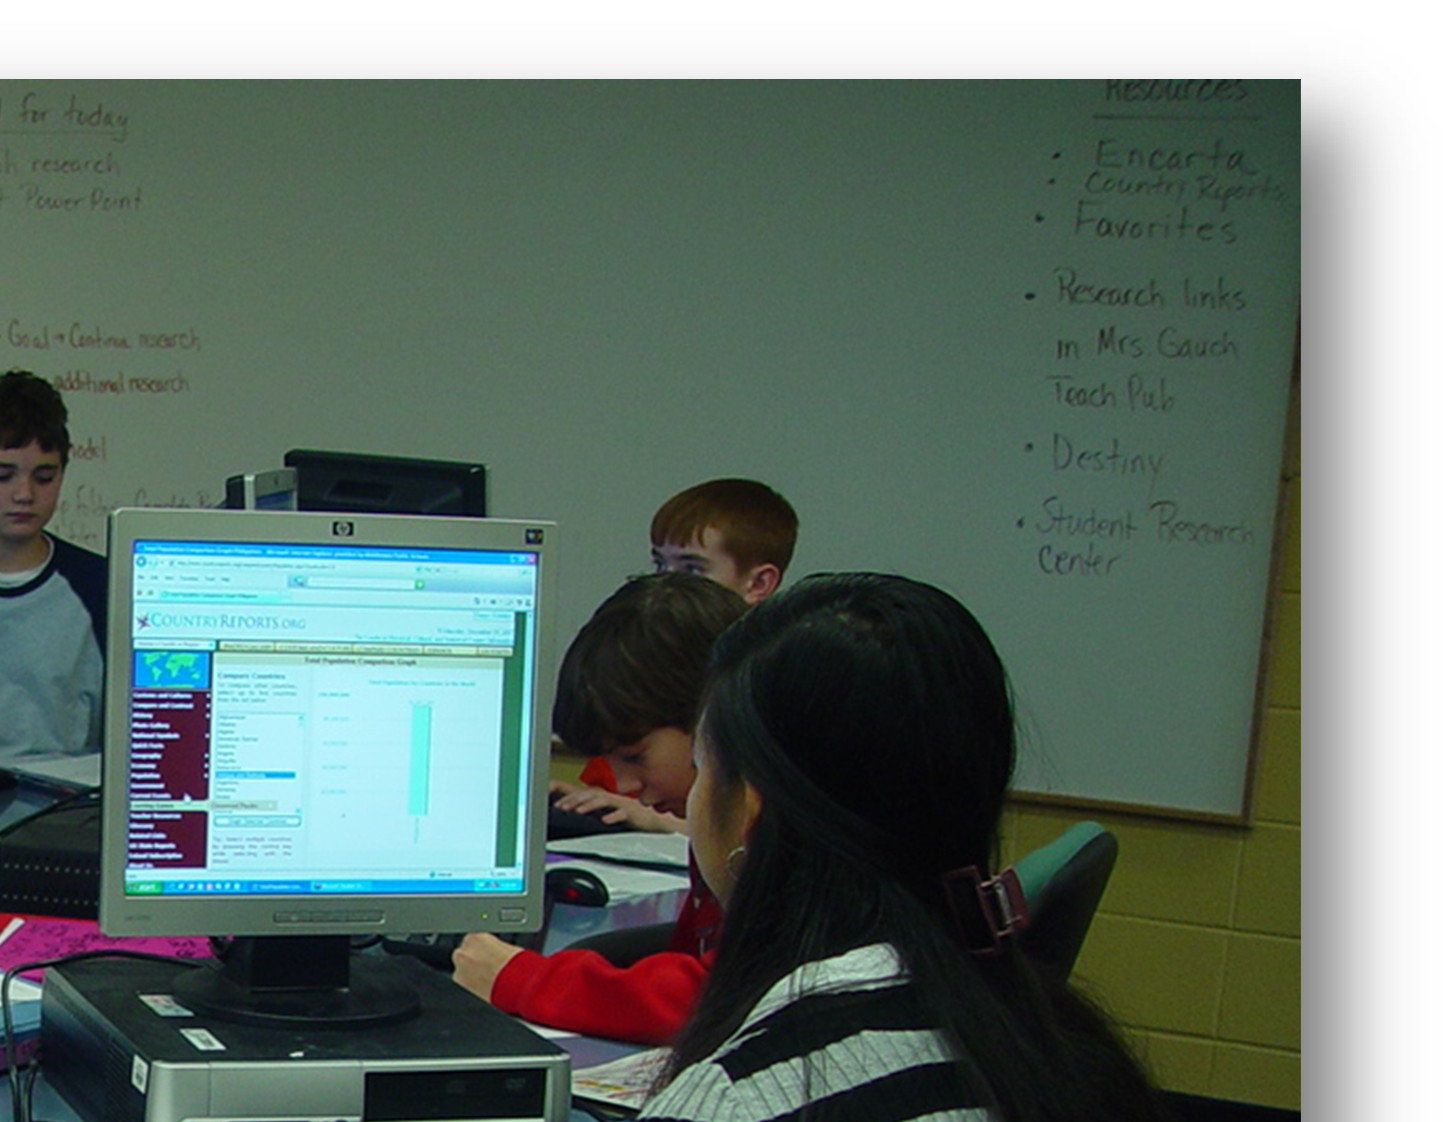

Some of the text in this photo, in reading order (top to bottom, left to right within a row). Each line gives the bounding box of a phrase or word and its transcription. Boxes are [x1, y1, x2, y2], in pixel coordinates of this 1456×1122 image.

[1105, 79, 1248, 102] Resources
[20, 91, 49, 123] for
[65, 94, 130, 143] today
[31, 152, 121, 177] research
[1095, 138, 1257, 176] Encarta
[1085, 170, 1186, 200] Country
[1074, 199, 1237, 245] Favorites
[1053, 267, 1247, 311] Research links
[7, 319, 49, 349] Goal
[1057, 339, 1080, 360] in
[54, 370, 190, 394] additional research
[1044, 374, 1117, 408] Teach
[1052, 432, 1164, 496] Destiny
[1035, 495, 1255, 544] Student Research
[1037, 543, 1122, 575] Center
